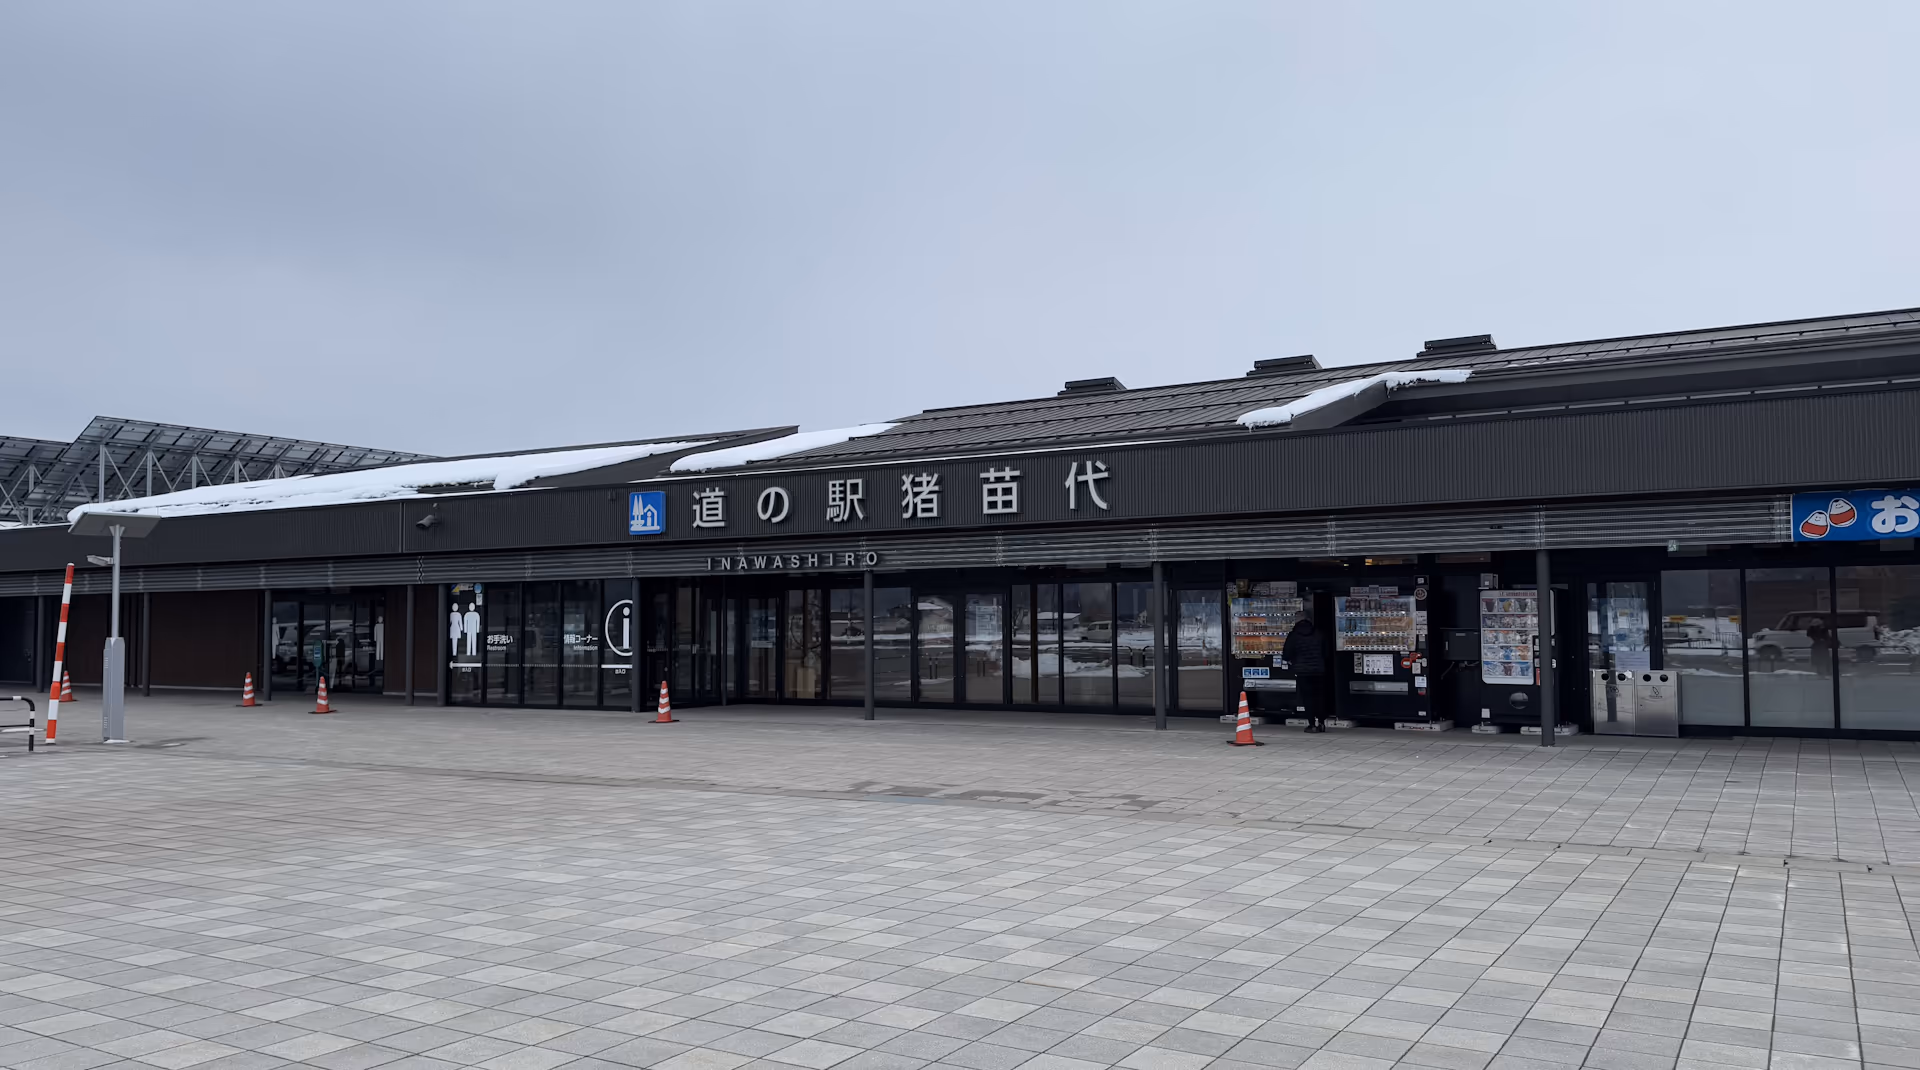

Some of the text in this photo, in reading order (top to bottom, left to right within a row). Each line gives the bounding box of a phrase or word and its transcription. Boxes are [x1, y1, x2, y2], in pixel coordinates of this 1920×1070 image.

[692, 460, 1109, 528] 道の駅猪苗代
[1871, 494, 1920, 534] お
[707, 551, 878, 571] INAWASHIRO
[487, 634, 514, 645] お手洗い
[563, 634, 598, 645] 情報コーナー
